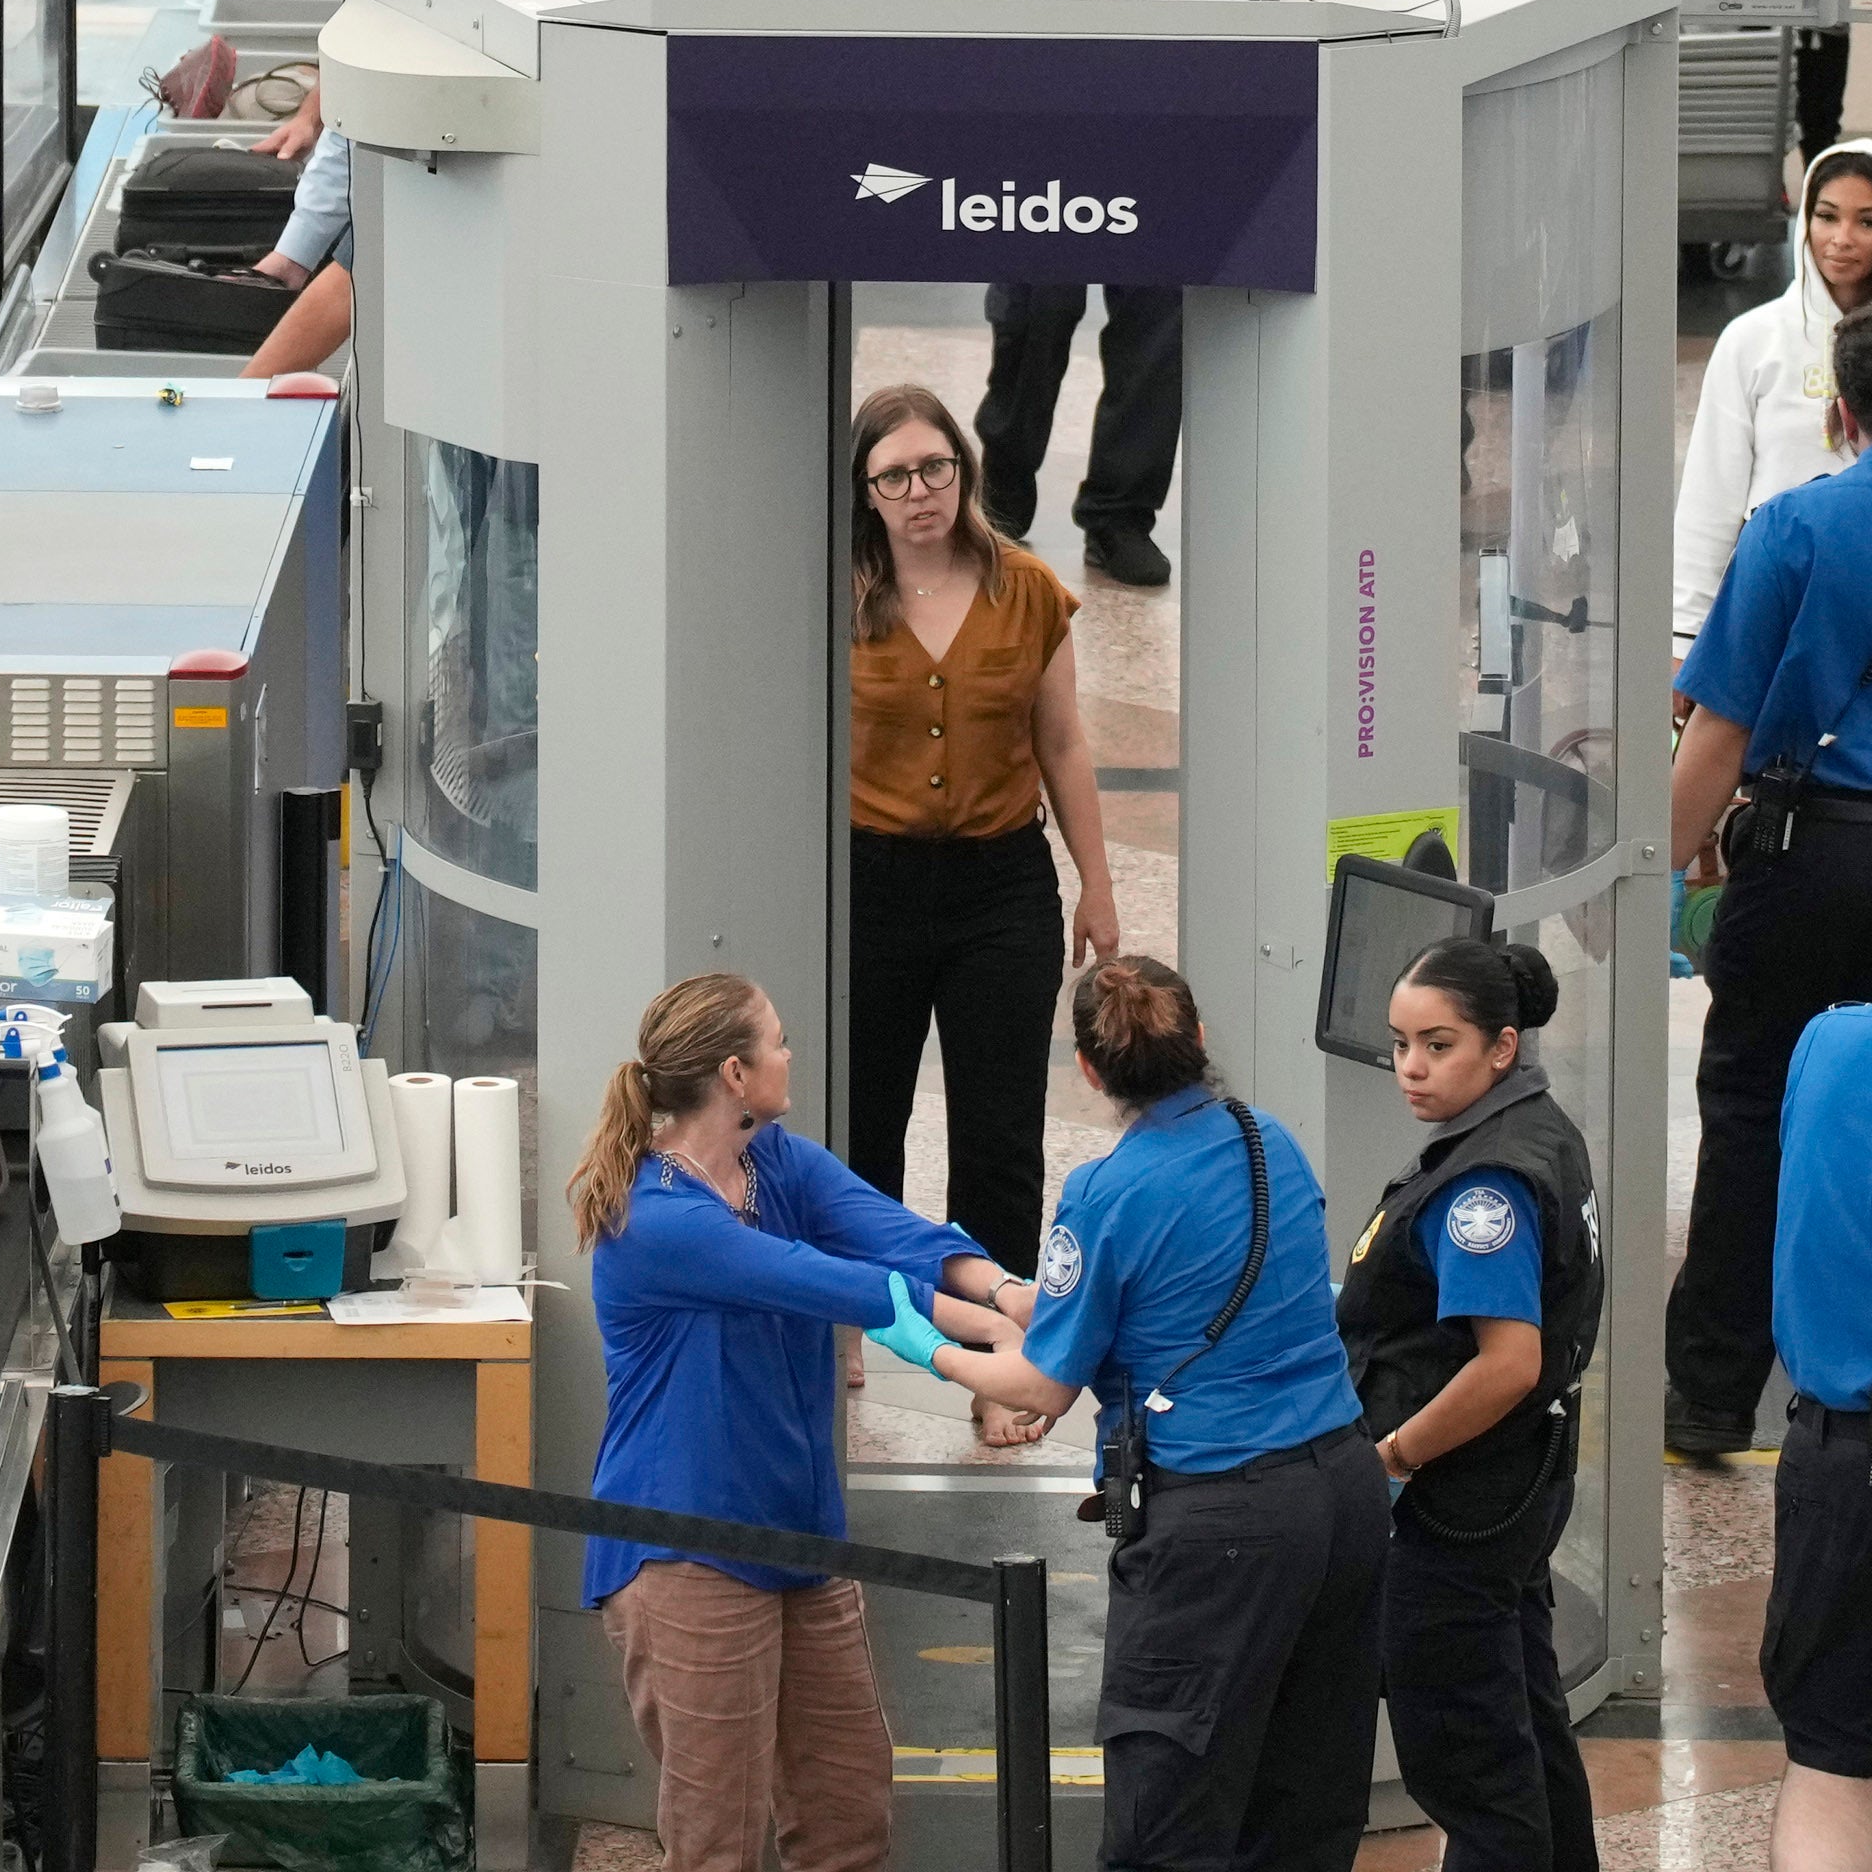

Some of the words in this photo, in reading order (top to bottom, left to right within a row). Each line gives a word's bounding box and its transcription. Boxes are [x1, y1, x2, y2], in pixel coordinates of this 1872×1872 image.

[941, 179, 1139, 235] leidos
[1358, 548, 1376, 599] ATD
[1358, 605, 1376, 759] PRO:VISION
[75, 985, 91, 996] 50
[244, 1162, 293, 1176] leidos
